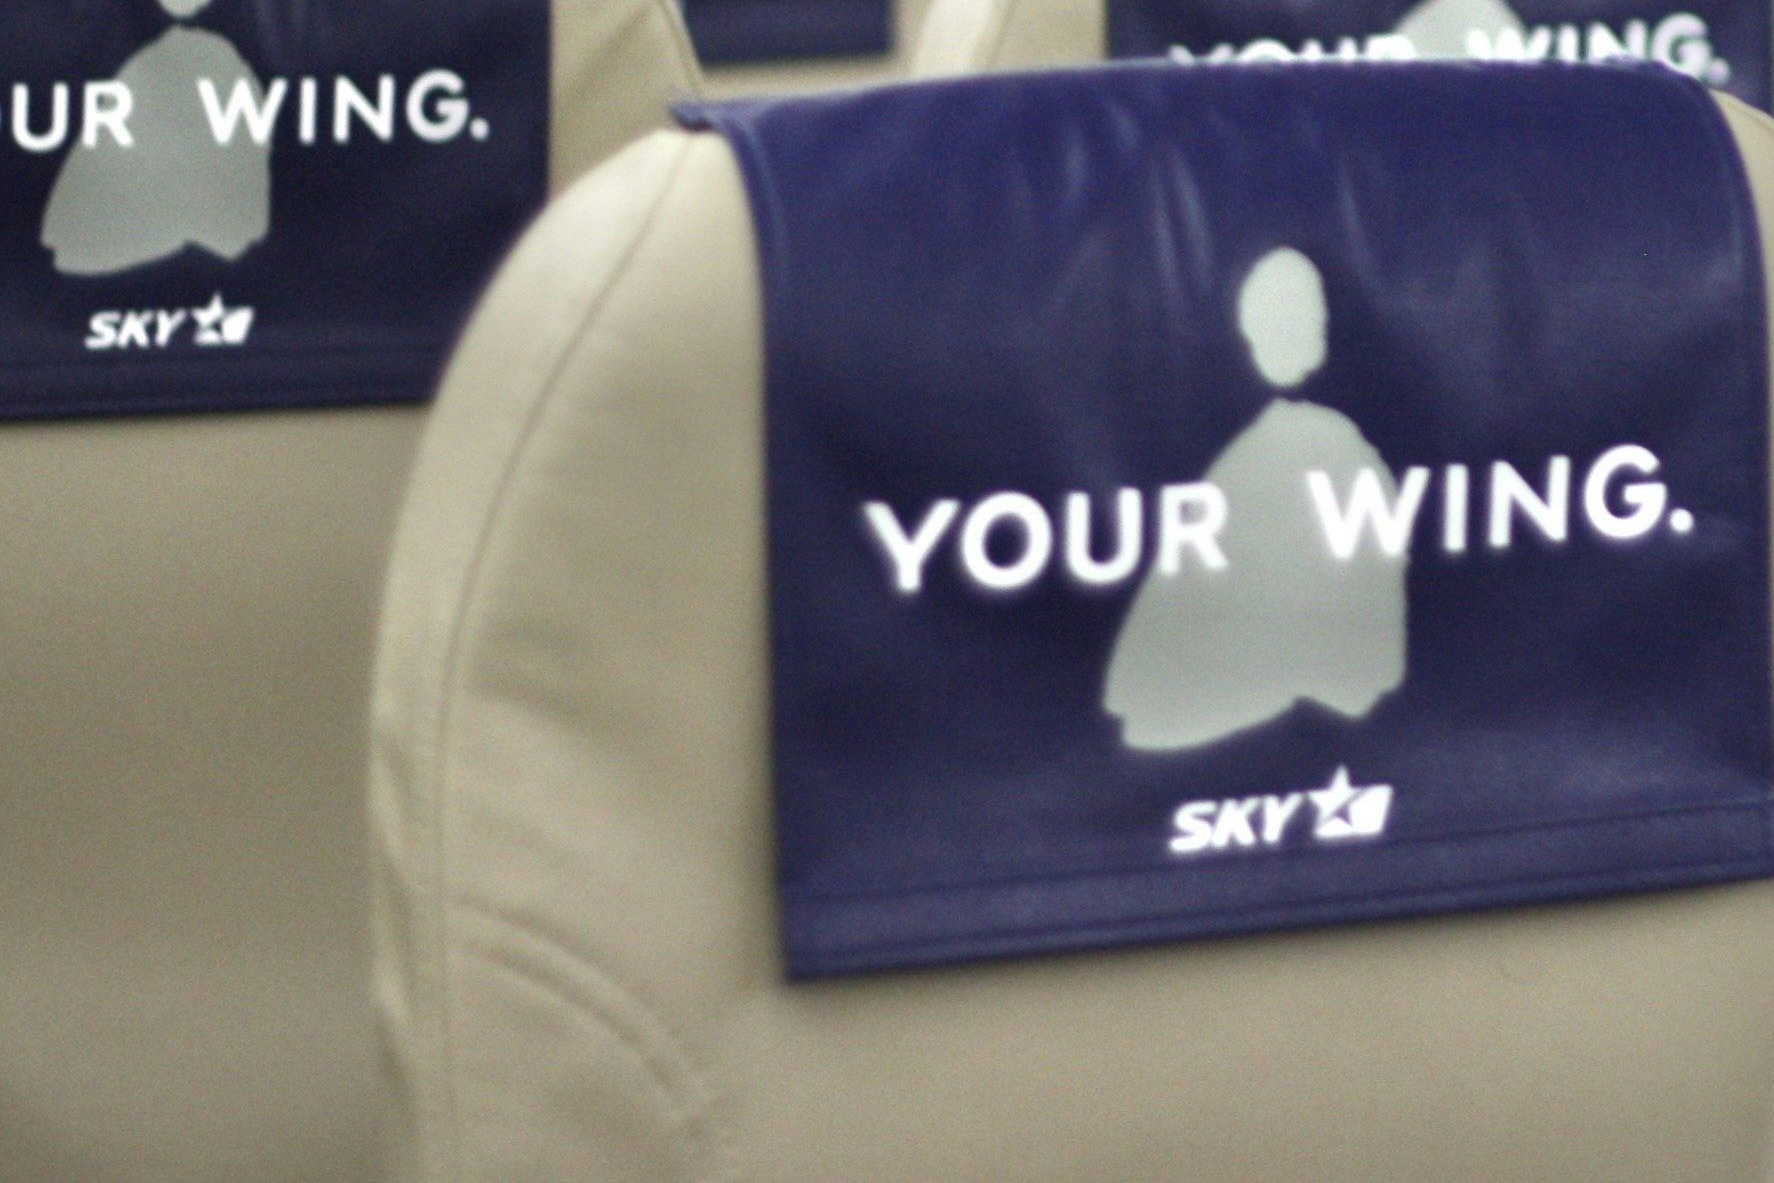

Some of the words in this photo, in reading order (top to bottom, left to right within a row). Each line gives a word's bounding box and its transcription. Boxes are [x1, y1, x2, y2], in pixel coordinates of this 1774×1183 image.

[0, 80, 134, 152] UR
[197, 69, 489, 146] WING.
[84, 309, 186, 350] SKY
[865, 482, 1230, 591] YOUR
[1307, 444, 1693, 560] WING.
[1168, 793, 1304, 853] SKY
